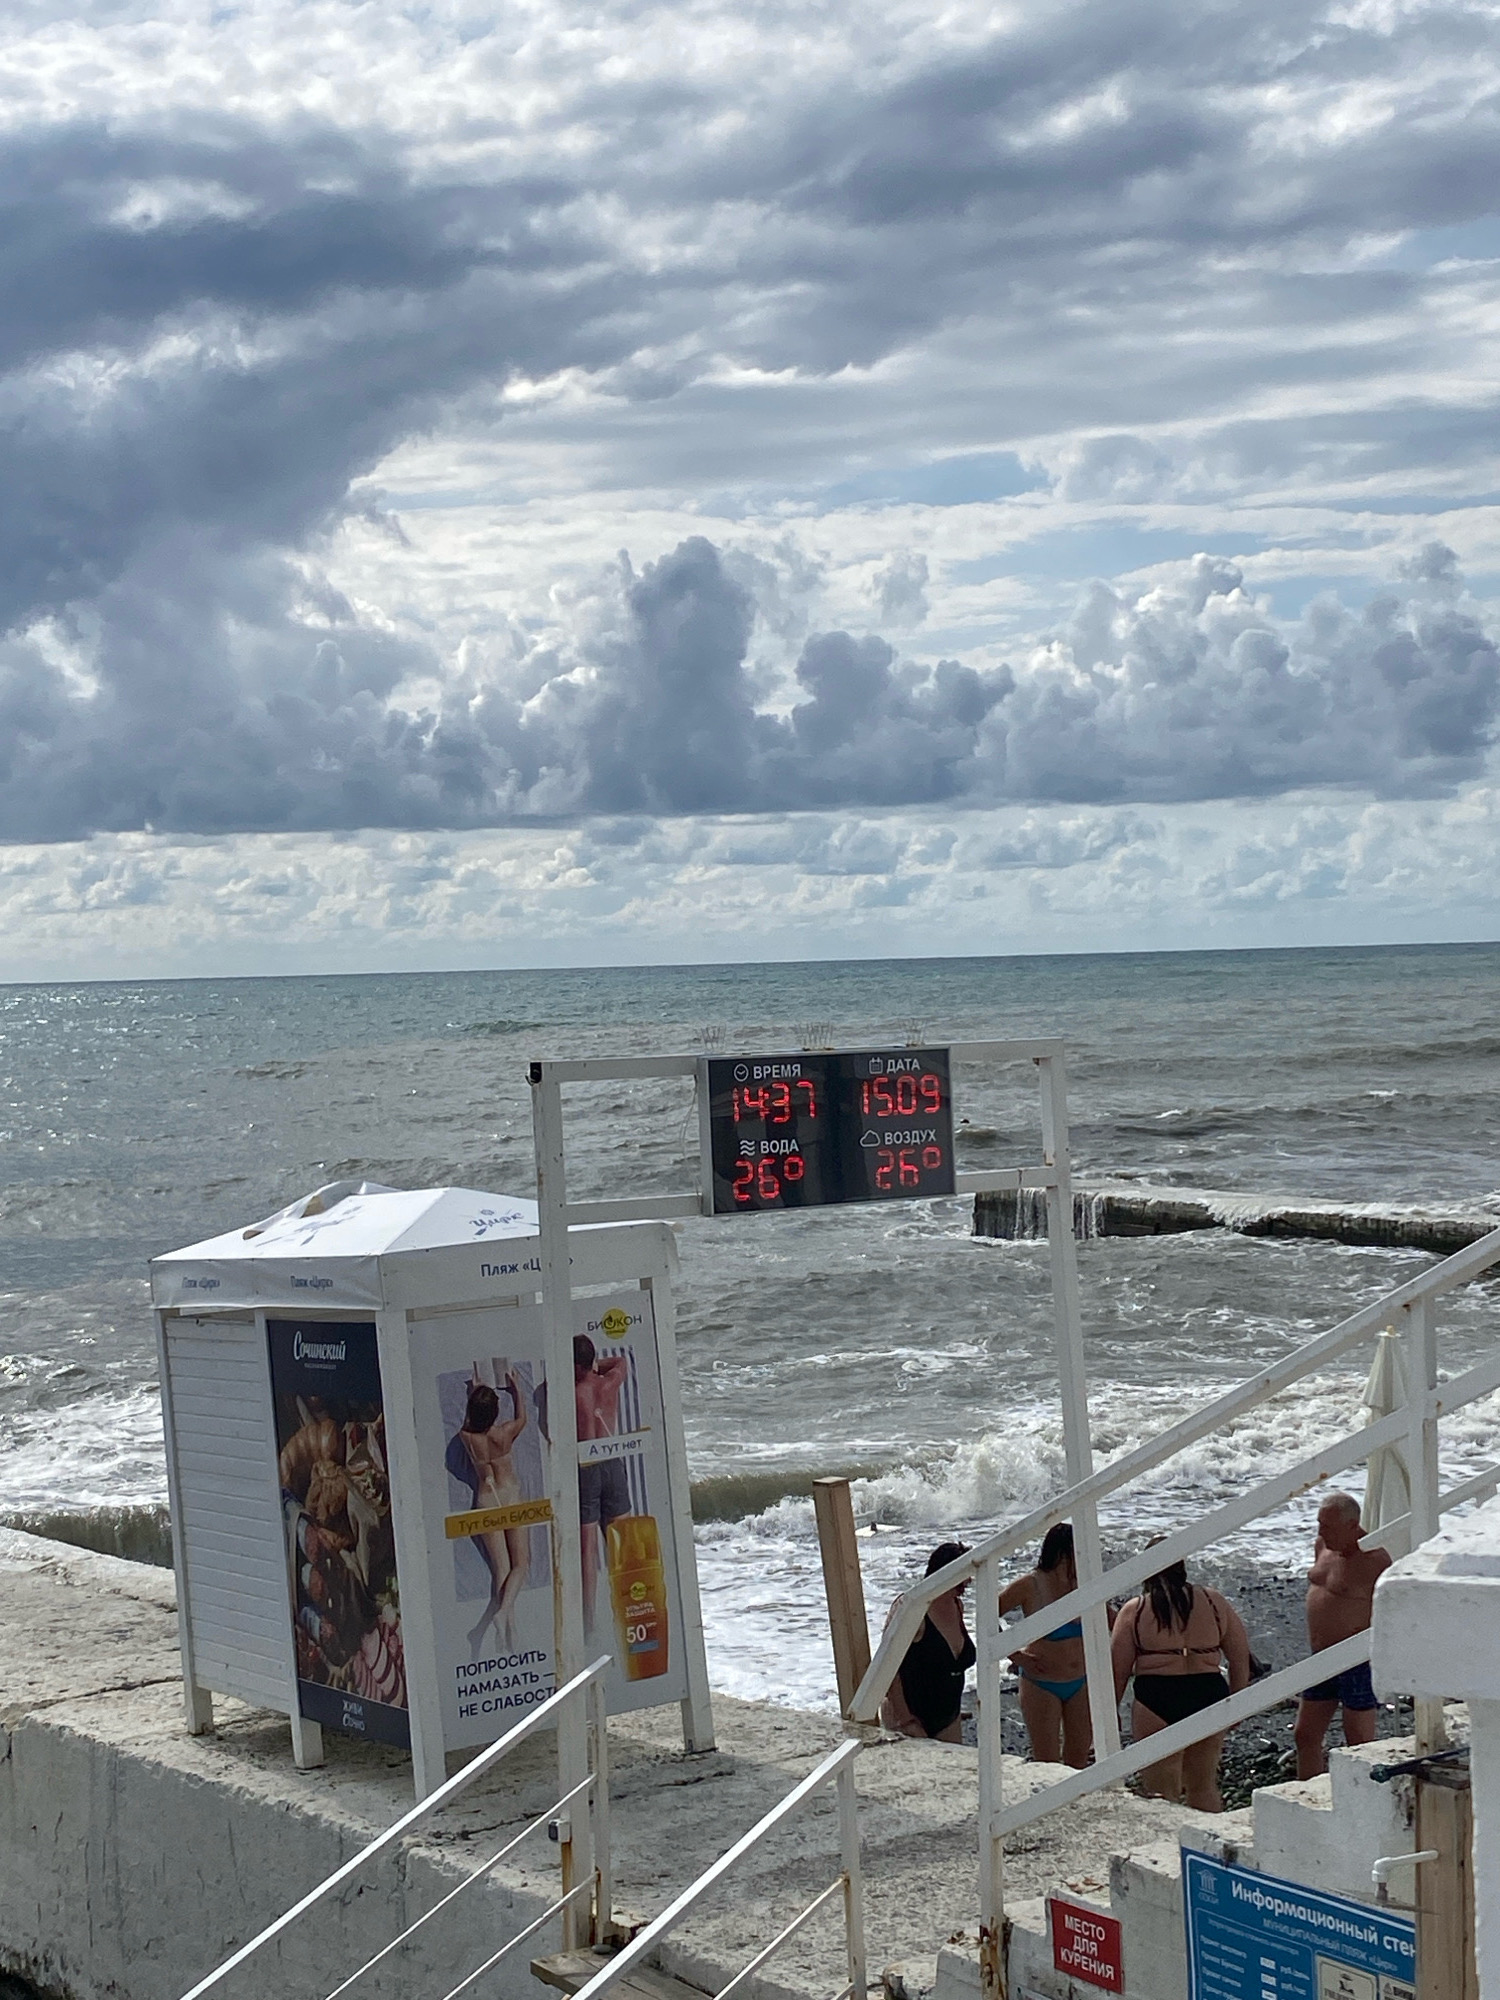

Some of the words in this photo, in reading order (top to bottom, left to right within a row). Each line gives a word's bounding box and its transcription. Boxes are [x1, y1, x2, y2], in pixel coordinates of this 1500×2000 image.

[753, 1064, 801, 1079] ВРЕМЯ
[886, 1058, 921, 1074] ДАТА
[760, 1139, 800, 1154] ВОДА
[884, 1129, 937, 1146] ВОЗДУХ
[481, 1263, 520, 1278] Пляж
[587, 1314, 642, 1332] БИОКОН
[293, 1330, 347, 1361] Сочинский
[589, 1444, 599, 1456] А
[601, 1442, 619, 1456] тут
[622, 1439, 643, 1451] нет
[458, 1519, 479, 1535] Тут
[482, 1514, 508, 1528] был
[509, 1504, 553, 1524] БИОКО
[626, 1624, 647, 1644] 50
[455, 1650, 547, 1679] ПОПРОСИТЬ
[457, 1671, 540, 1698] НАМАЗАТЬ
[459, 1702, 479, 1719] НЕ
[1064, 1914, 1106, 1941] МЕСТО
[1230, 1879, 1379, 1946] Информационный
[1382, 1934, 1415, 1959] стен
[1072, 1935, 1098, 1957] ДЛЯ
[1060, 1946, 1115, 1980] КУРЕНИЯ
